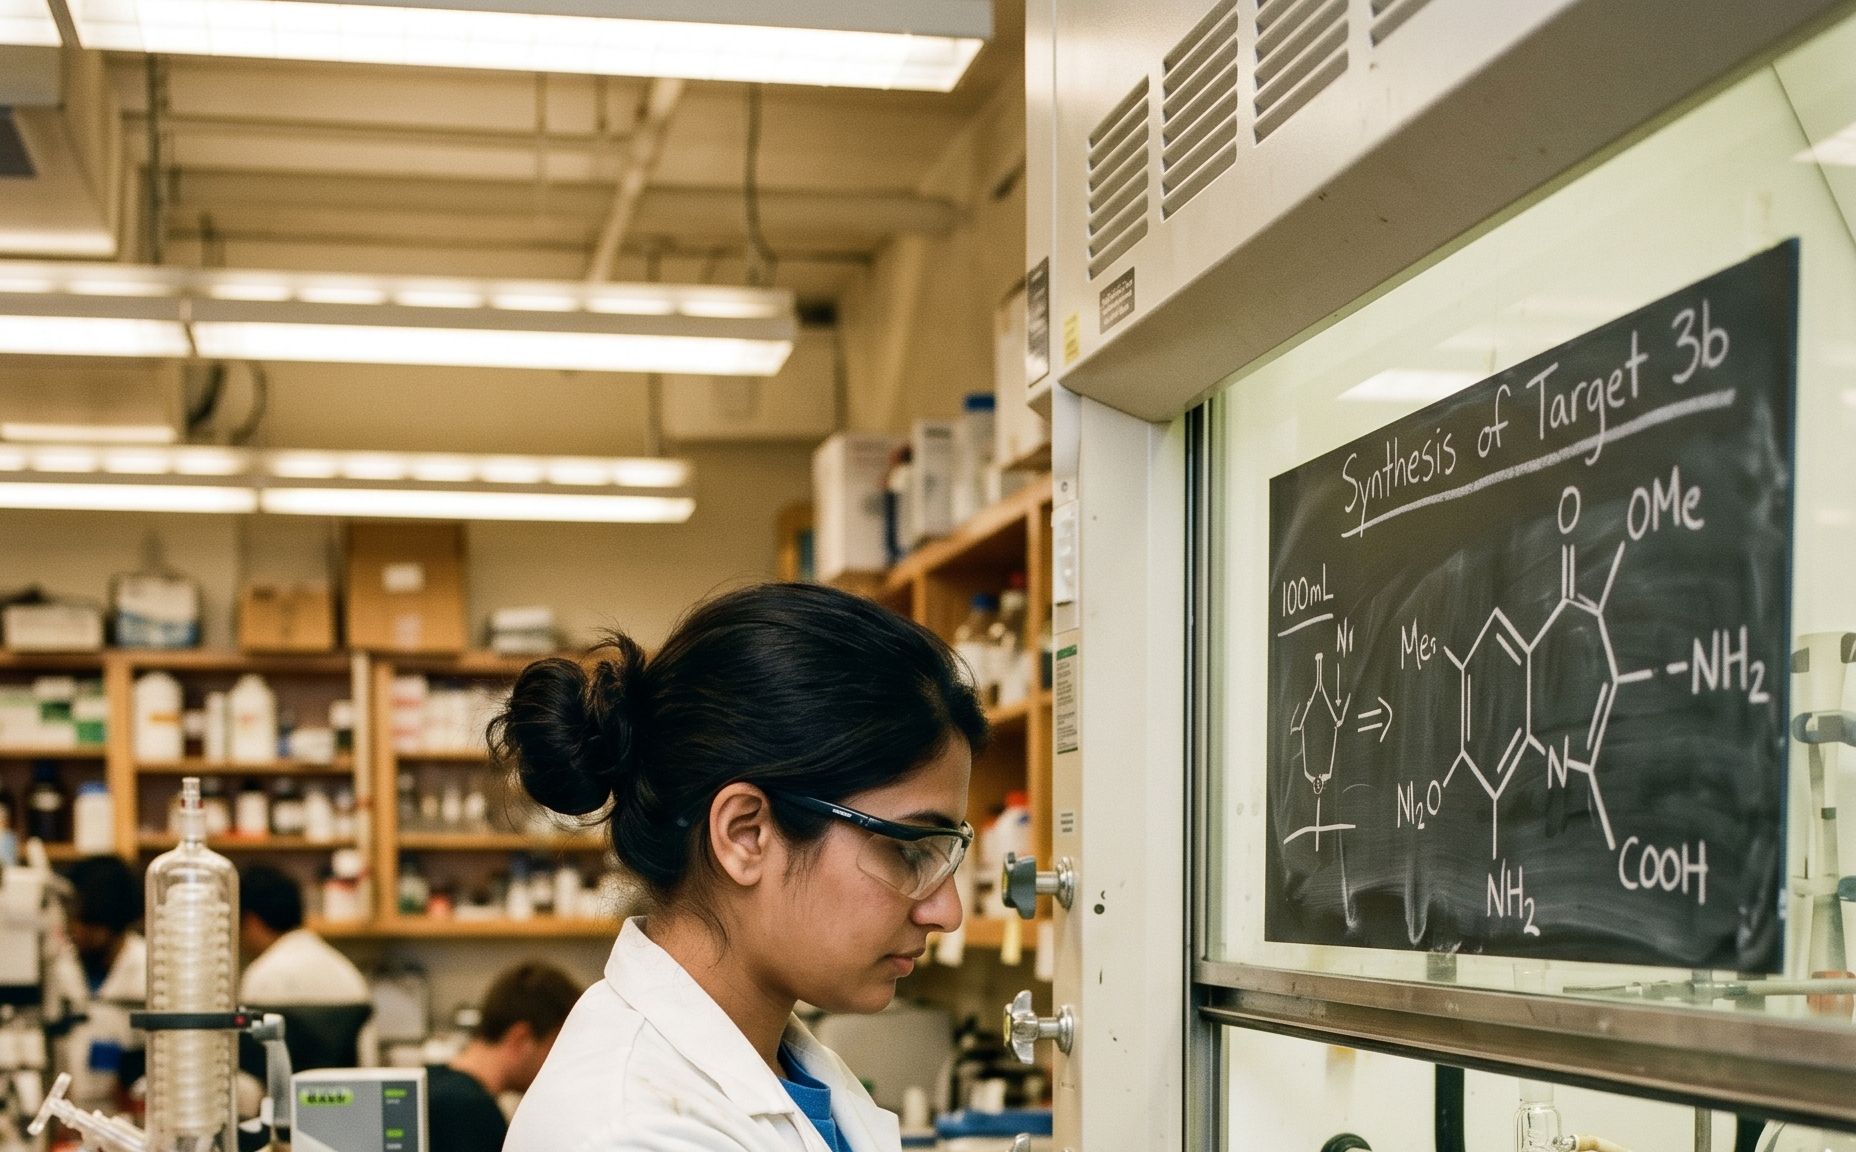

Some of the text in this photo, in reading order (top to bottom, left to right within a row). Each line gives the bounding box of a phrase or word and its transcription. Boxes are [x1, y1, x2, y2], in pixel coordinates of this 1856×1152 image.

[1341, 299, 1730, 537] Synthesis of Target 3b
[1557, 485, 1582, 535] O
[1627, 465, 1705, 541] OMe
[1282, 562, 1334, 617] 100mL
[1547, 735, 1570, 789] N
[1618, 836, 1710, 905] COOH
